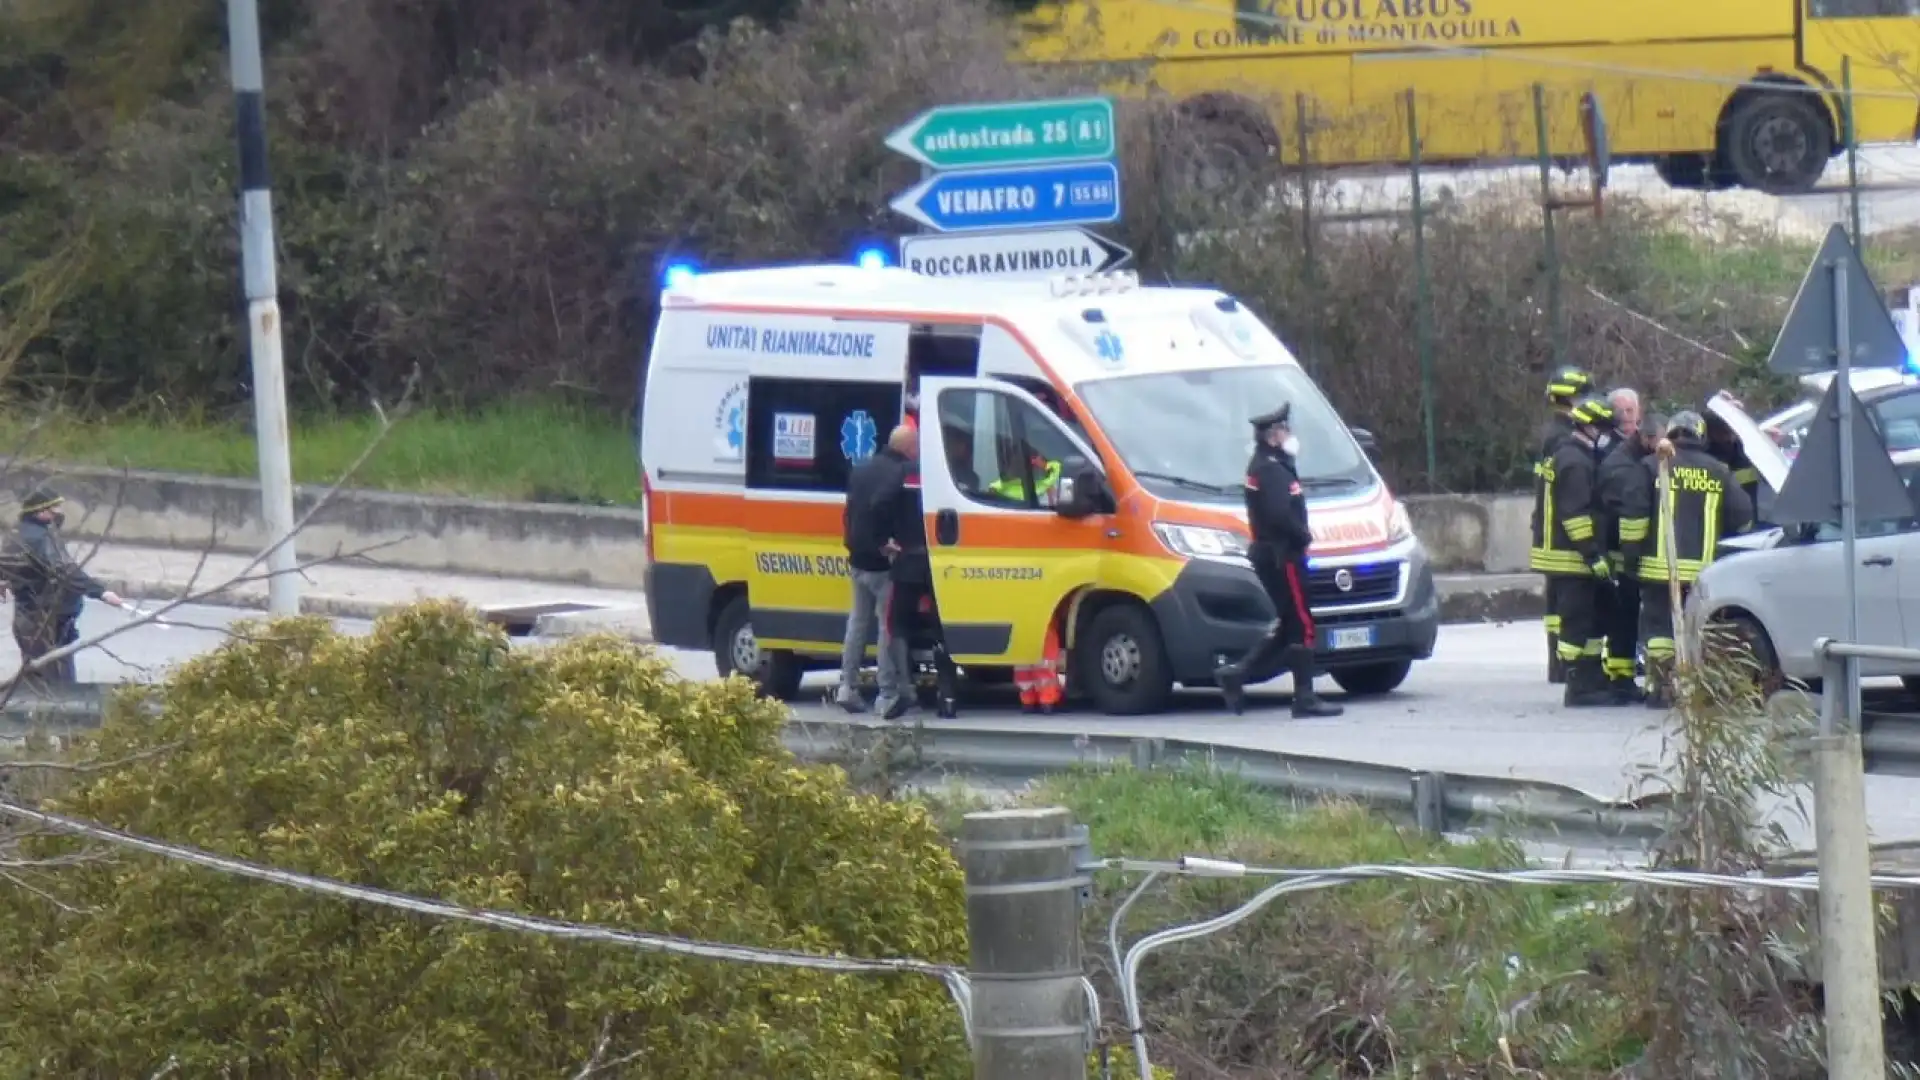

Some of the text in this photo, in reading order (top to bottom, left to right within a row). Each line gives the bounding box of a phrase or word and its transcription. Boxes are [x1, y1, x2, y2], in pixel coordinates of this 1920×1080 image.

[924, 121, 1035, 151] autostrada
[1042, 119, 1068, 144] 25
[936, 185, 1036, 214] VENAFRO
[1052, 183, 1065, 208] 7
[911, 247, 1092, 277] ROCCARAVINDOLA
[761, 328, 875, 358] RIANIMAZIONE
[1673, 466, 1708, 480] VIGILI
[755, 551, 813, 575] ISERNIA
